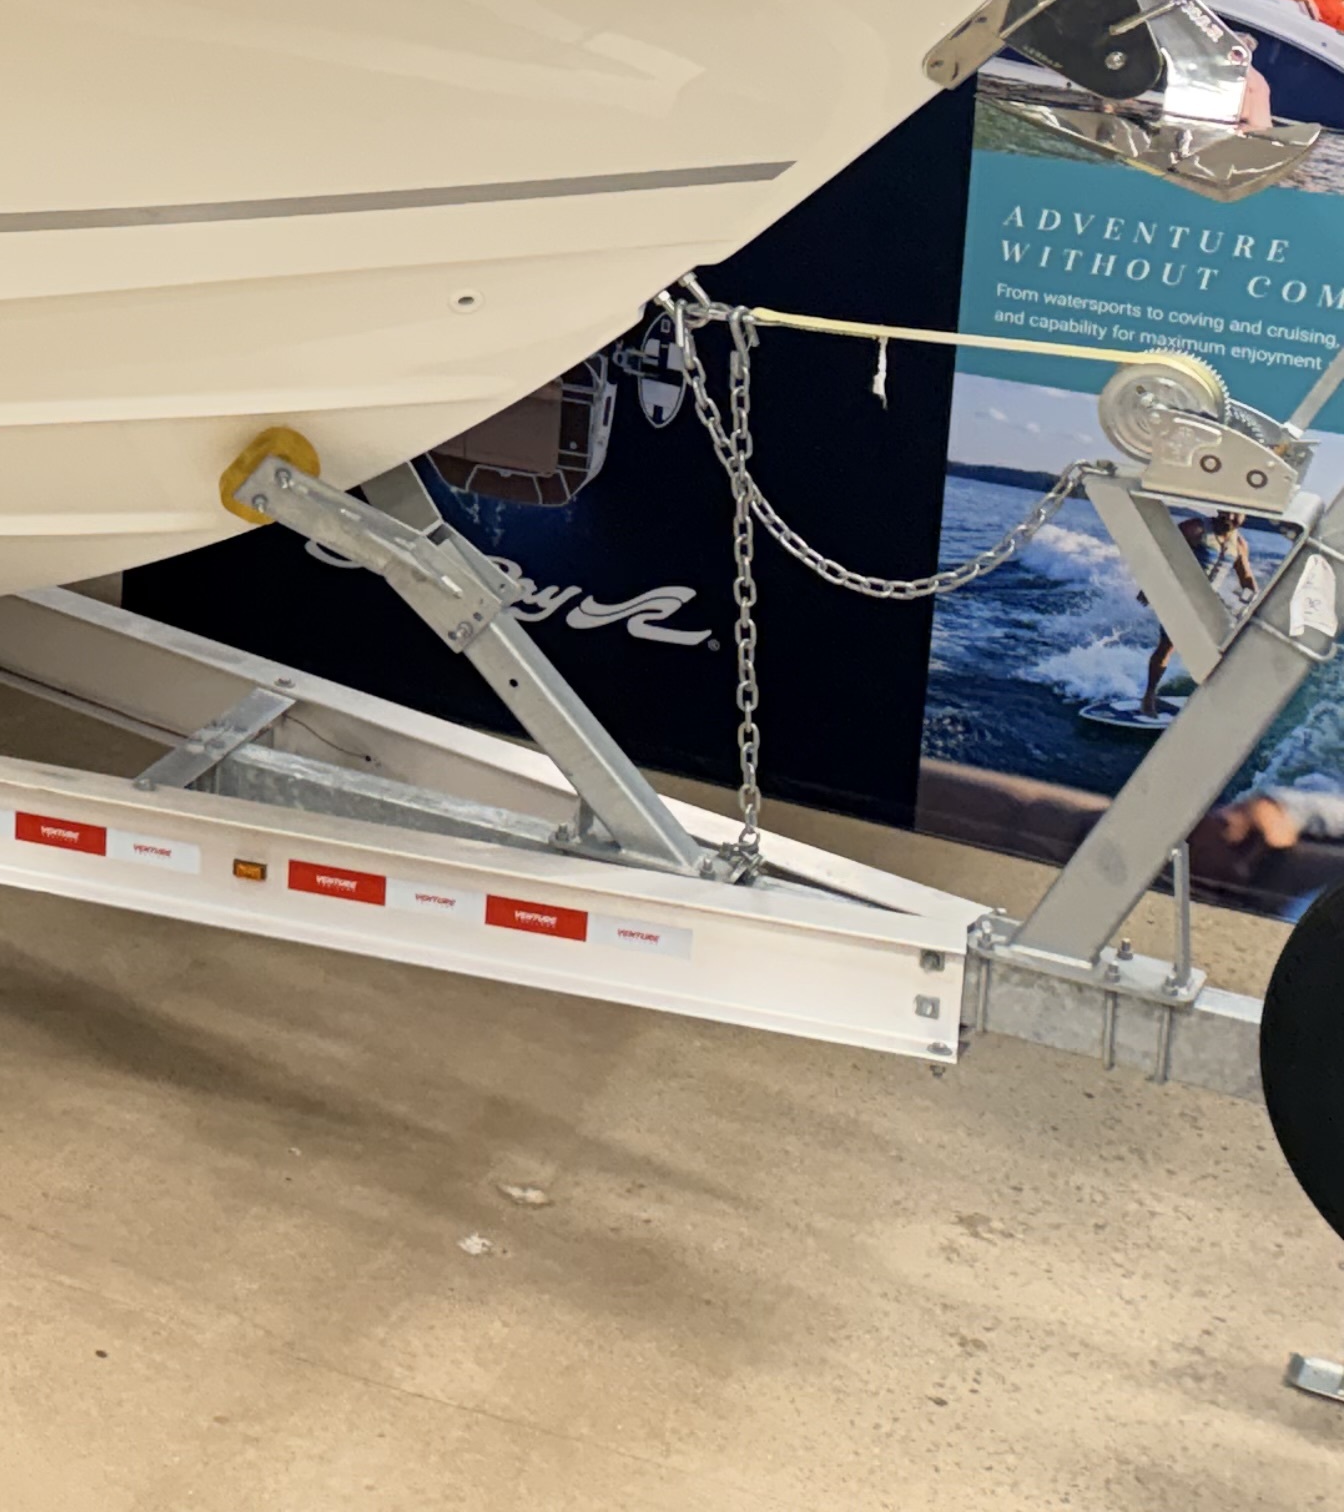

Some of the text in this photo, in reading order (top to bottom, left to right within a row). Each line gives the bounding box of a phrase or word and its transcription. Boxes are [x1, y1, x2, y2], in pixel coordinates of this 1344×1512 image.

[1003, 205, 1290, 263] ADVENTURE
[1000, 239, 1219, 291] WITHOUT
[994, 308, 1323, 371] and capability for maximum enjoyment
[996, 282, 1342, 349] From watersports to coving and cruising,
[617, 928, 661, 943] VENTURE
